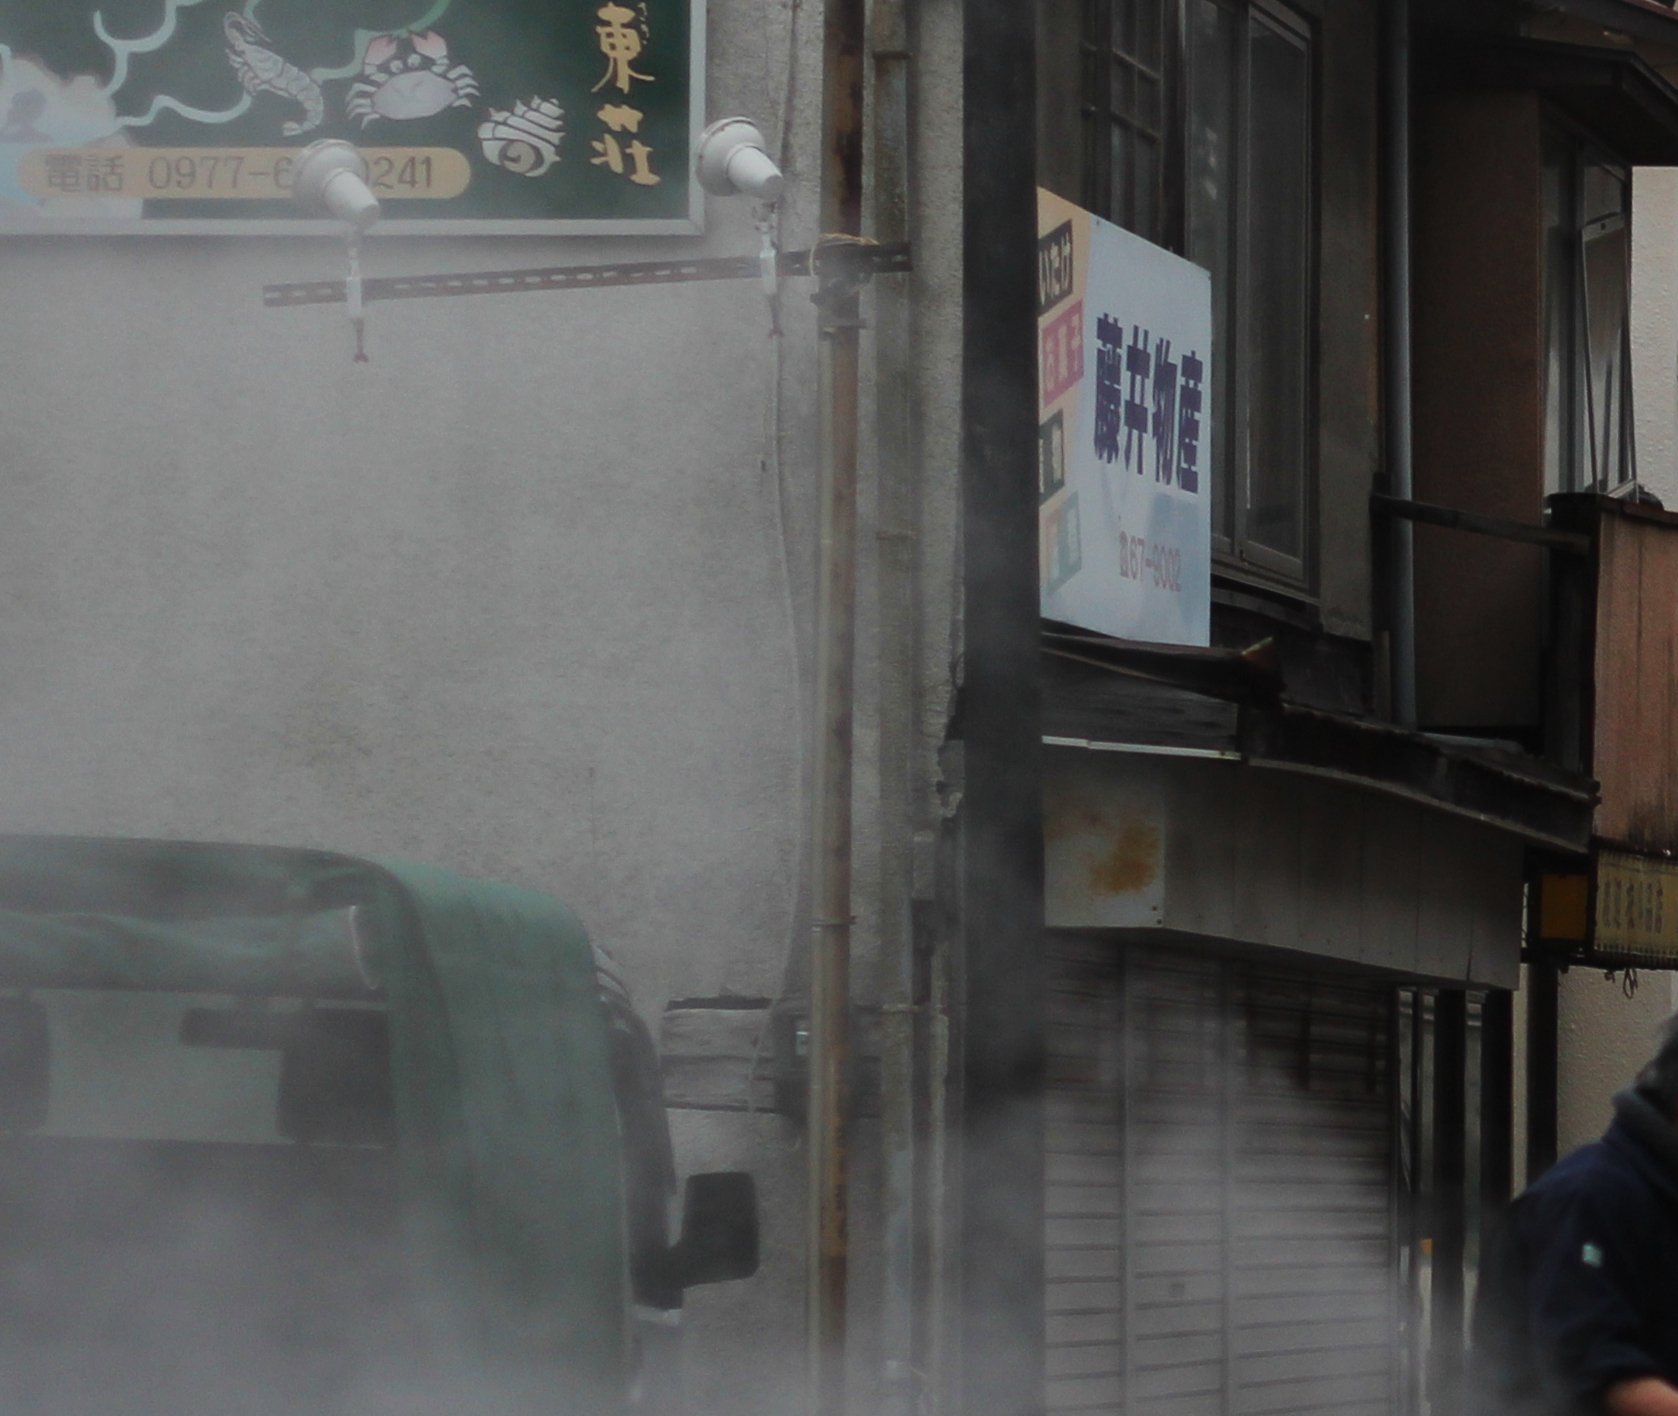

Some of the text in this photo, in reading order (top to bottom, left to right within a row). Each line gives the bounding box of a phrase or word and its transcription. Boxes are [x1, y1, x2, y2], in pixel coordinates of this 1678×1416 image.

[44, 154, 433, 192] 電話 0977-6241
[1094, 312, 1203, 494] 藤井物産
